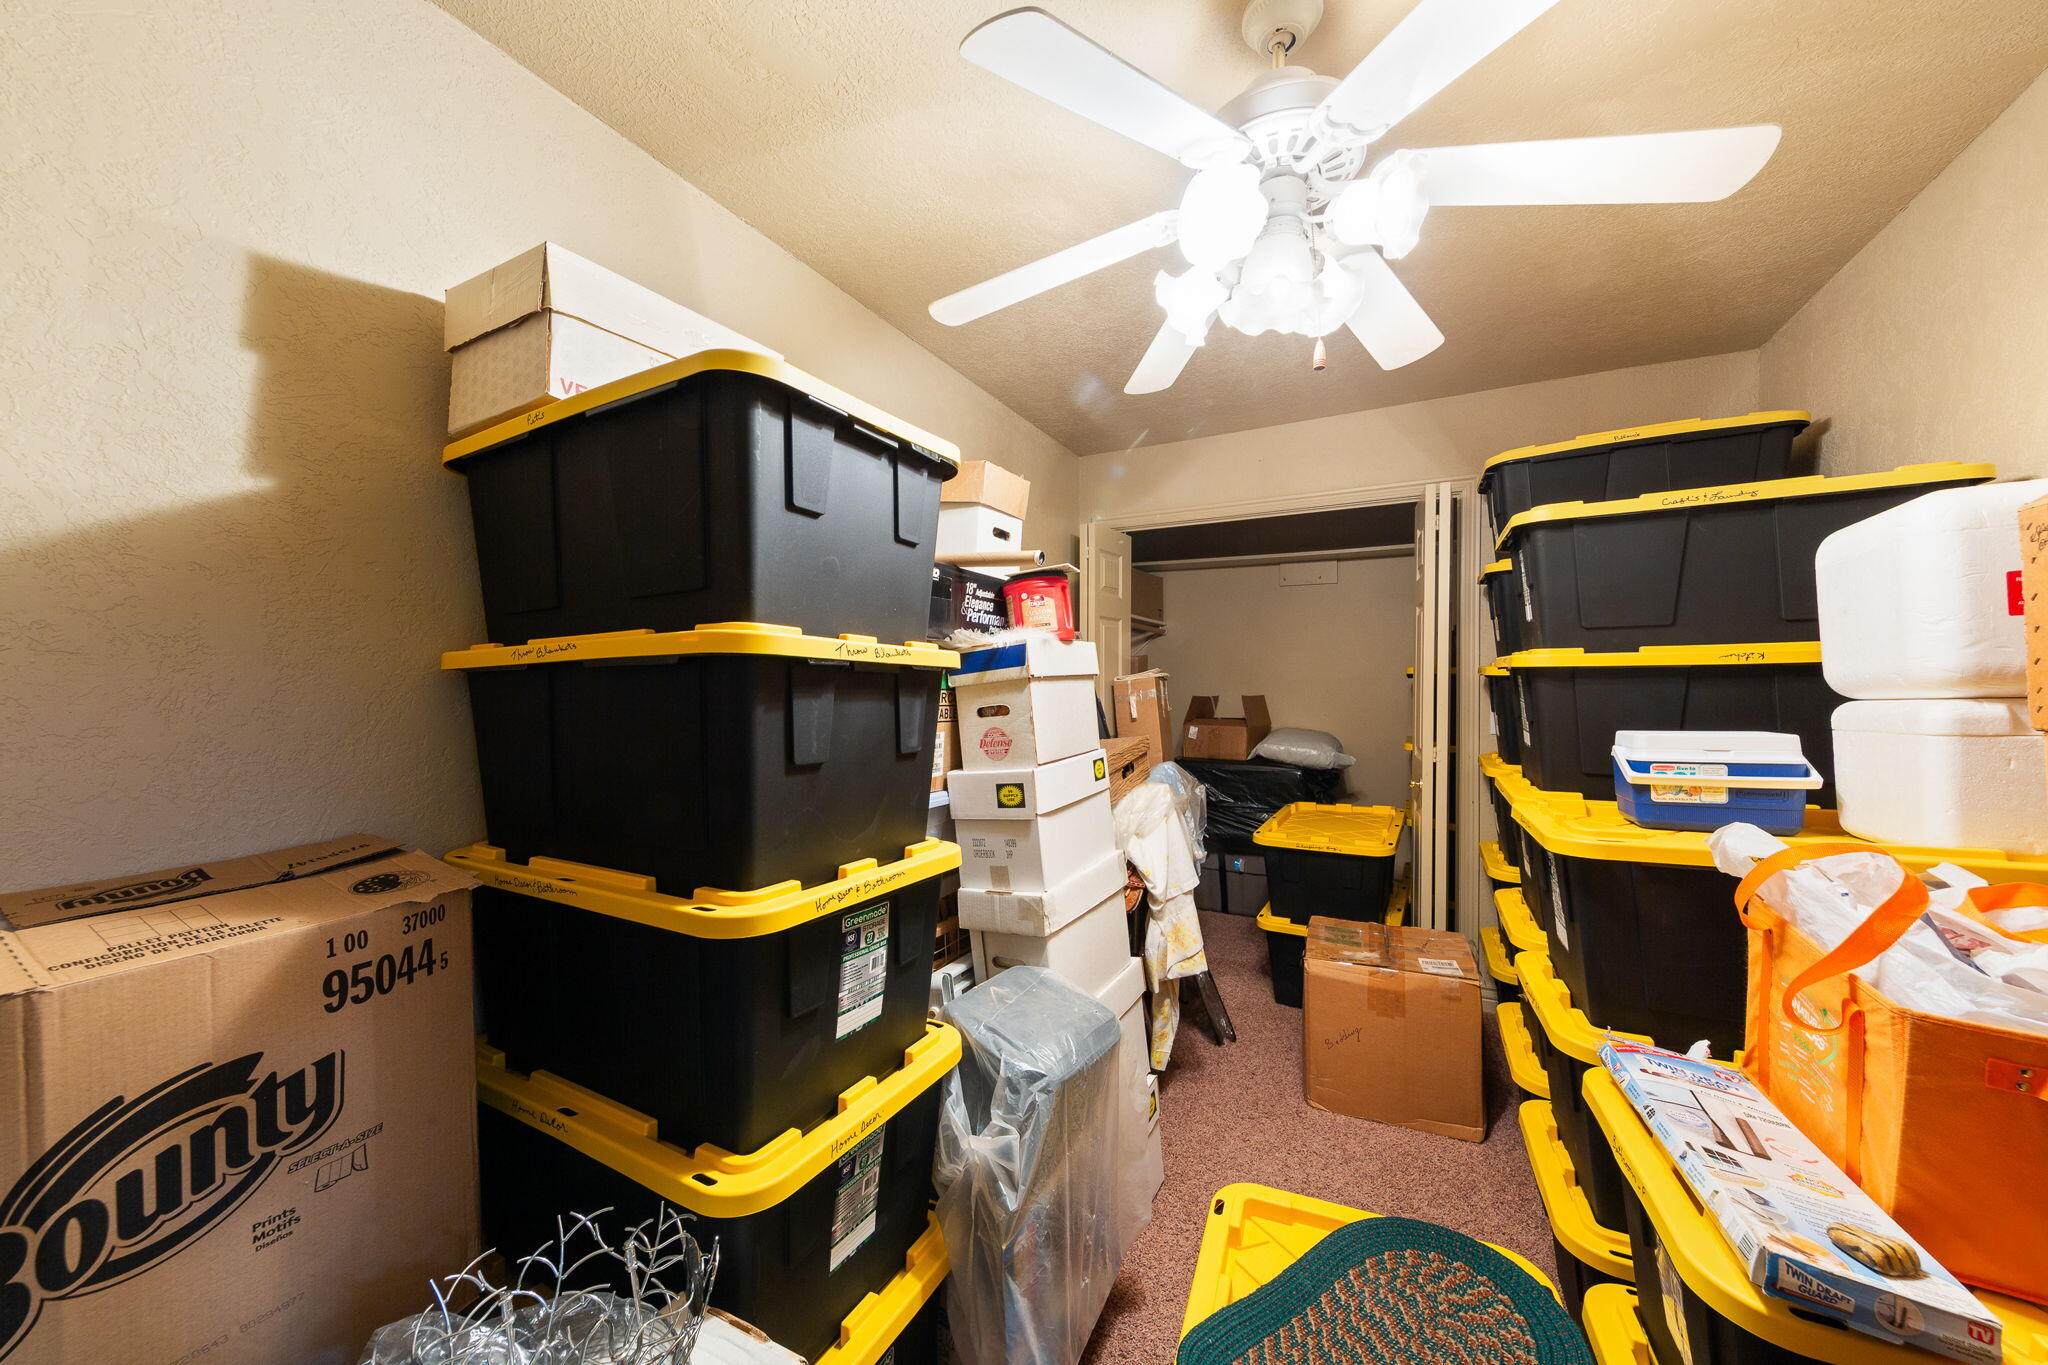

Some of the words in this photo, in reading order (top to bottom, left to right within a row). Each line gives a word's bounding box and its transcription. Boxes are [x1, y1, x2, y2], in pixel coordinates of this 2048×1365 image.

[964, 595, 994, 612] Elegance
[402, 904, 446, 936] 37000
[845, 907, 886, 928] Greenmade
[48, 940, 179, 972] CONFIGURATION
[184, 933, 203, 944] DE
[207, 928, 226, 938] LA
[231, 916, 284, 932] PALETTE
[106, 937, 162, 953] PALLET
[167, 923, 230, 940] PATTERN
[151, 946, 172, 956] DE
[178, 925, 268, 950] PLATAFORMA
[325, 938, 337, 958] 1
[343, 930, 369, 953] 00
[322, 938, 437, 1014] 95044
[440, 951, 449, 970] 5
[830, 1130, 858, 1159] Home
[252, 1206, 297, 1233] Prints
[252, 1215, 302, 1245] Motifs
[255, 1230, 294, 1252] Diseños
[1785, 1262, 1813, 1287] TWIN
[1817, 1281, 1853, 1304] DRAFT
[1799, 1284, 1839, 1306] GUARD
[1970, 1325, 1993, 1342] TV
